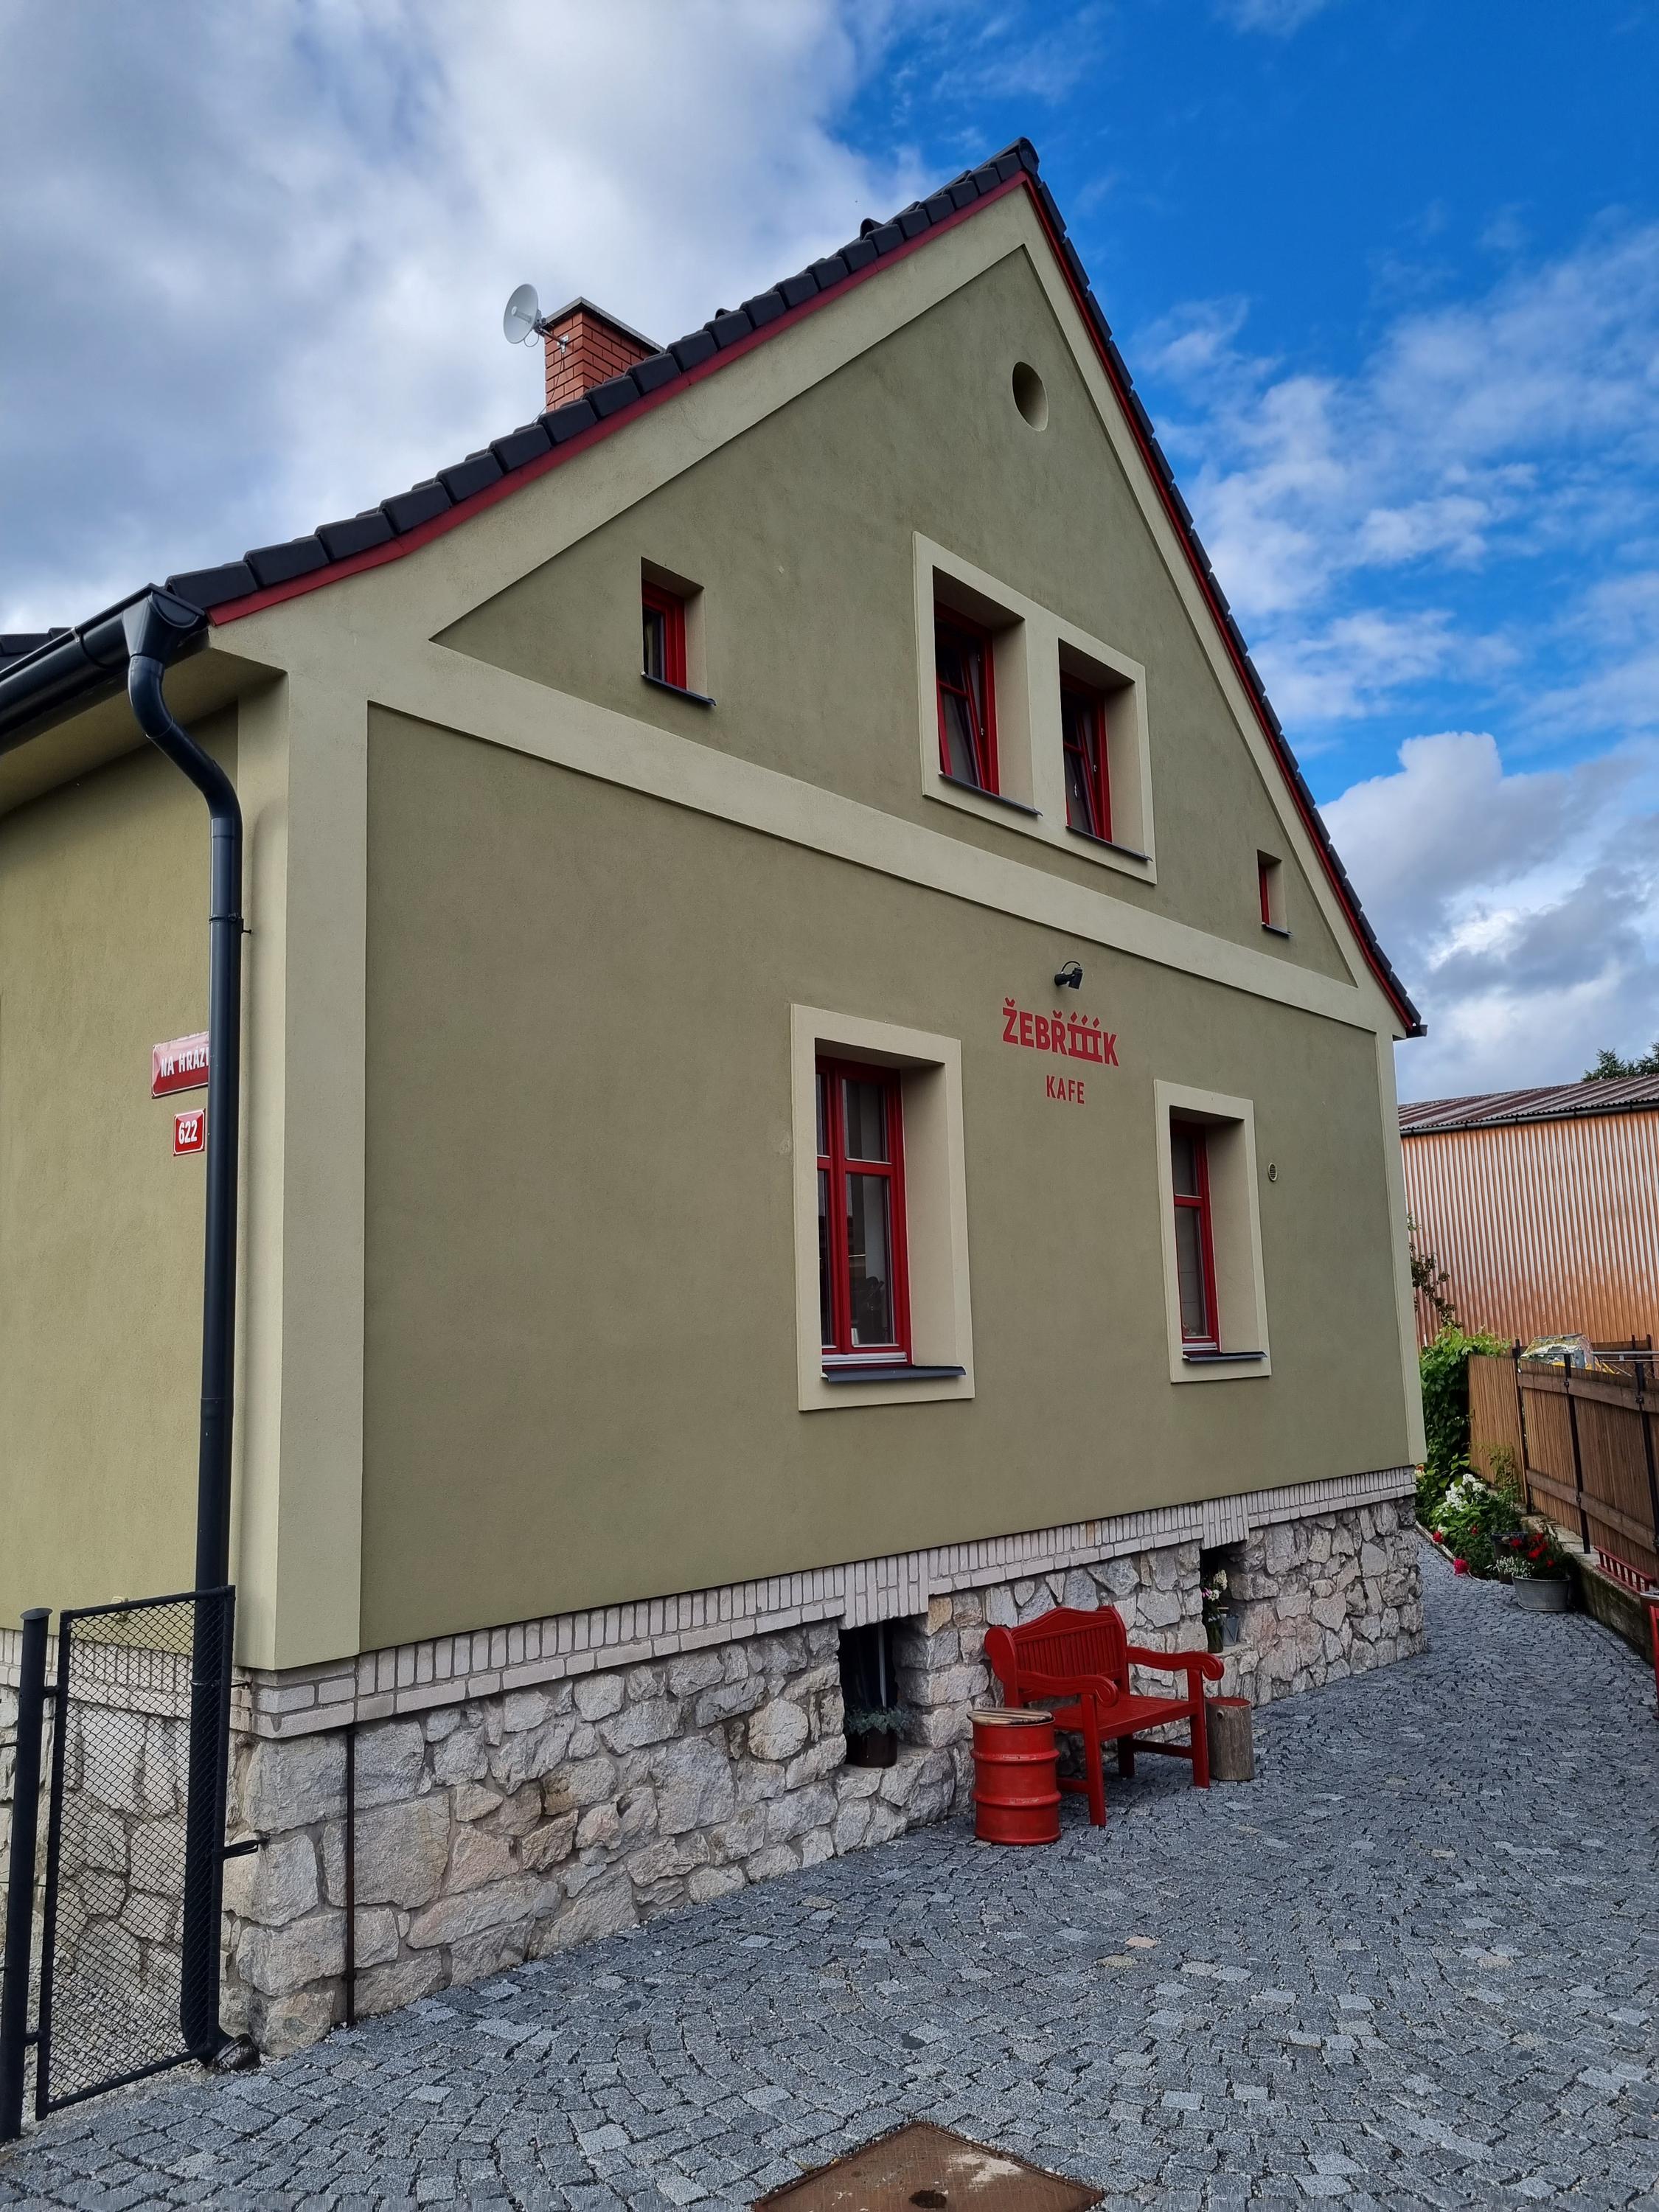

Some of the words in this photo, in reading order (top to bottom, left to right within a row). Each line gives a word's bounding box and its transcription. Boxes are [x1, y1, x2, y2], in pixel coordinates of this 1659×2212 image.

[161, 1055, 175, 1078] NA
[1046, 1074, 1085, 1105] KAFE
[178, 1119, 198, 1145] 622
